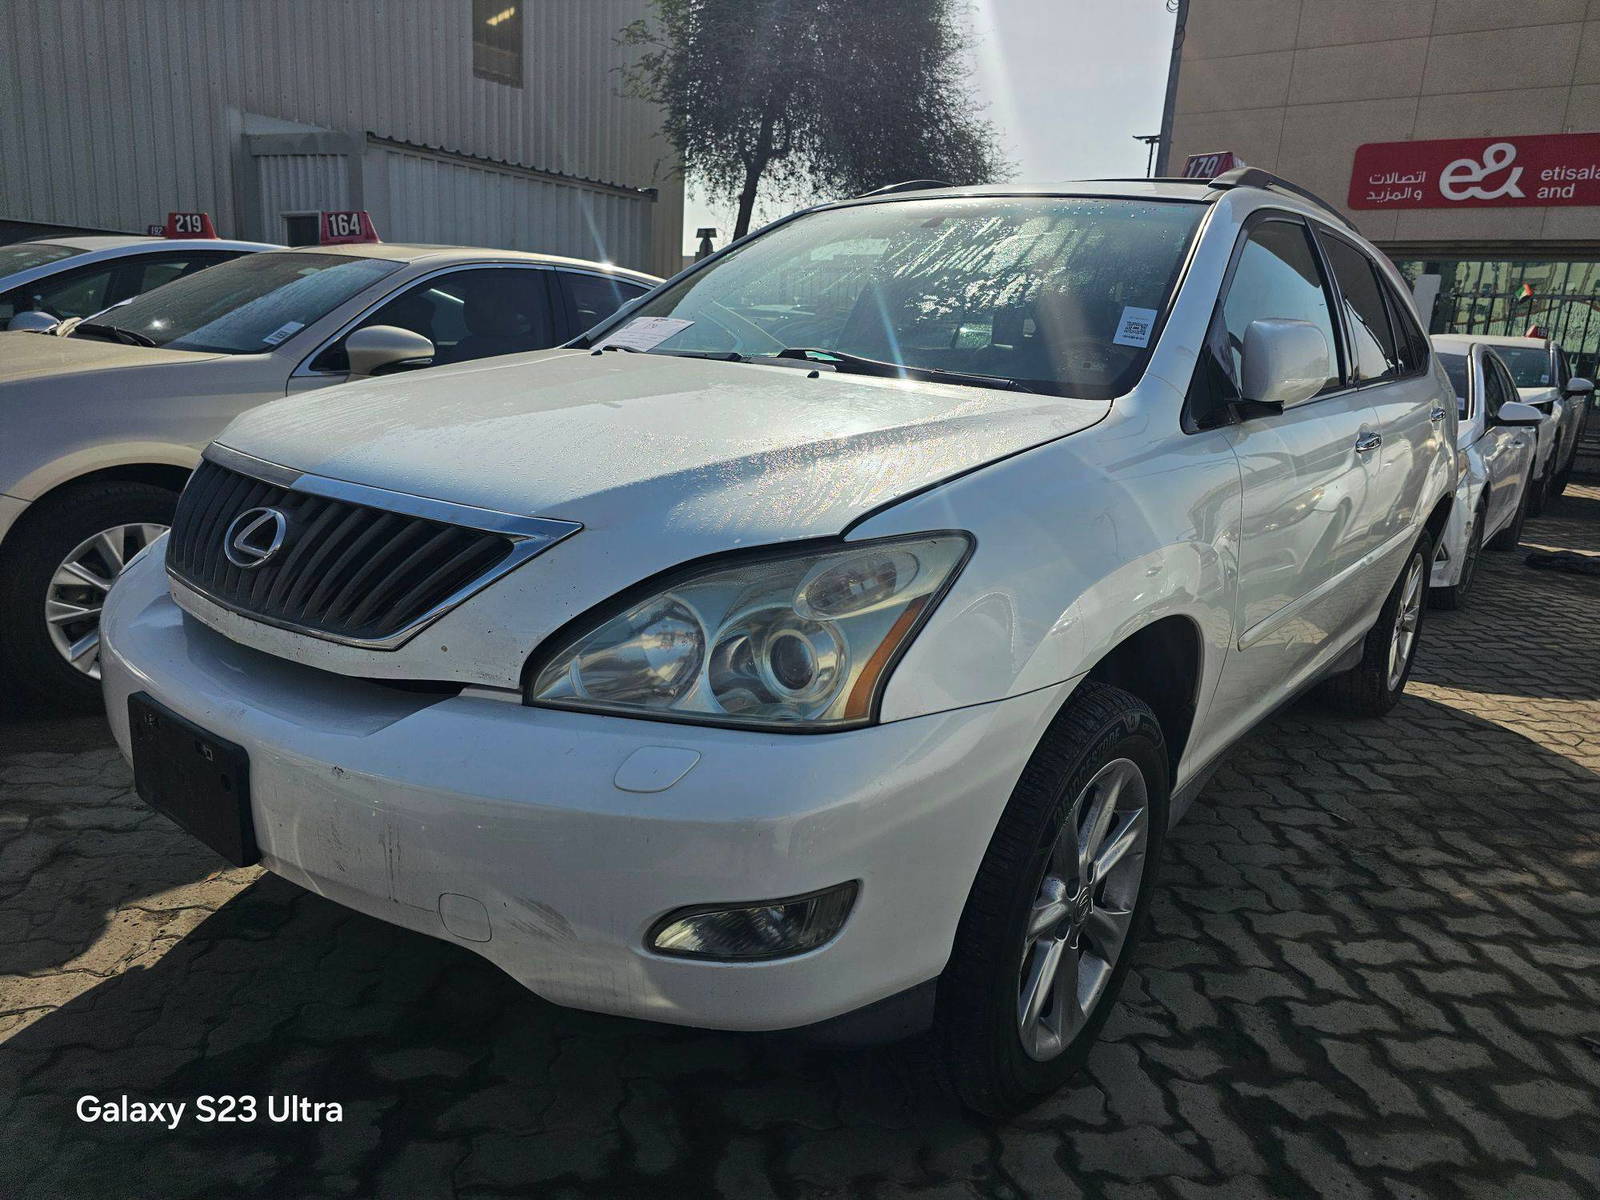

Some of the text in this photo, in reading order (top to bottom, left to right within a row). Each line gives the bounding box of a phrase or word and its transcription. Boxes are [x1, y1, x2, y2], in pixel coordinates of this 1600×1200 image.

[1187, 156, 1218, 178] 179
[1369, 171, 1426, 184] اتصالات
[1536, 183, 1576, 199] and
[175, 214, 202, 232] 219
[329, 213, 360, 236] 164
